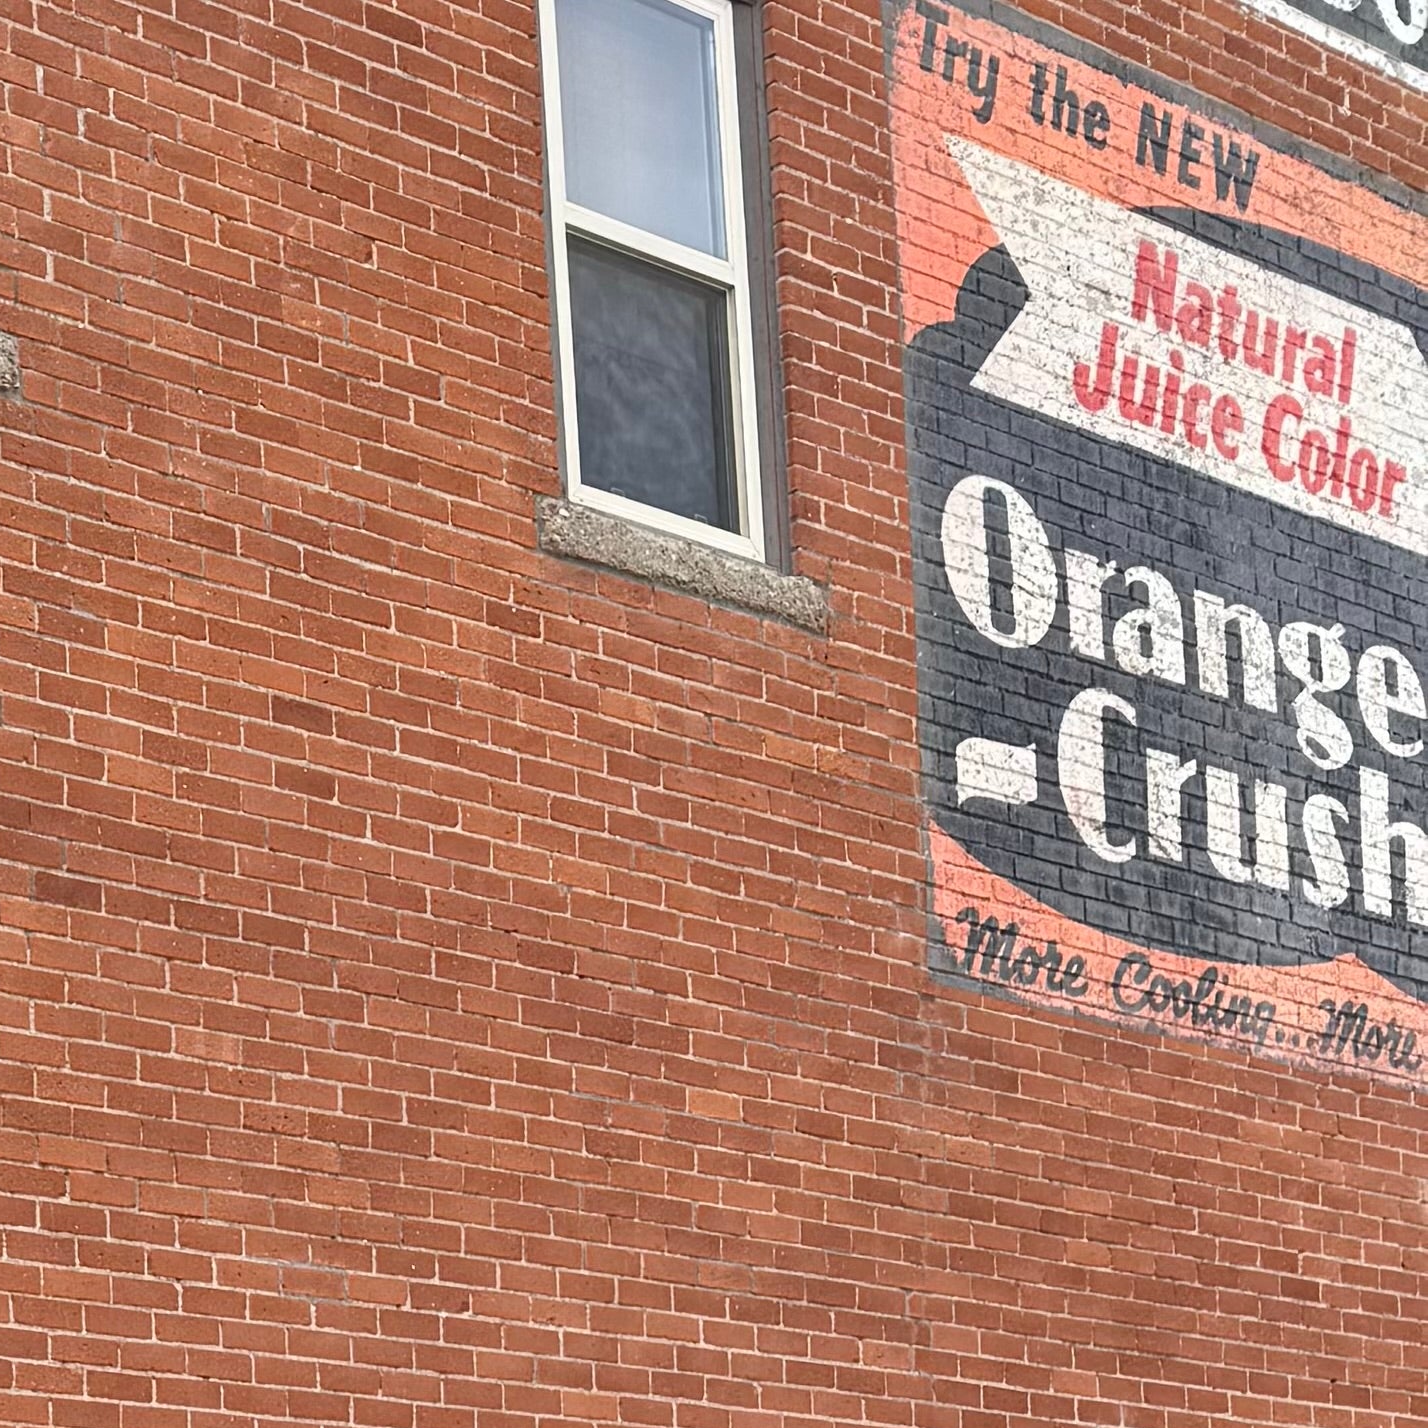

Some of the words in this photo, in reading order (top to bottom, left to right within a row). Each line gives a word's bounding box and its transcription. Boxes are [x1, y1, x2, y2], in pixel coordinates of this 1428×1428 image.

[914, 0, 1000, 125] Try
[1028, 61, 1111, 151] the
[1135, 102, 1260, 215] NEW
[1073, 321, 1244, 461] Juice
[1261, 392, 1408, 519] Color
[1131, 239, 1358, 405] Natural
[941, 474, 1428, 770] Orange
[955, 906, 1090, 998] More
